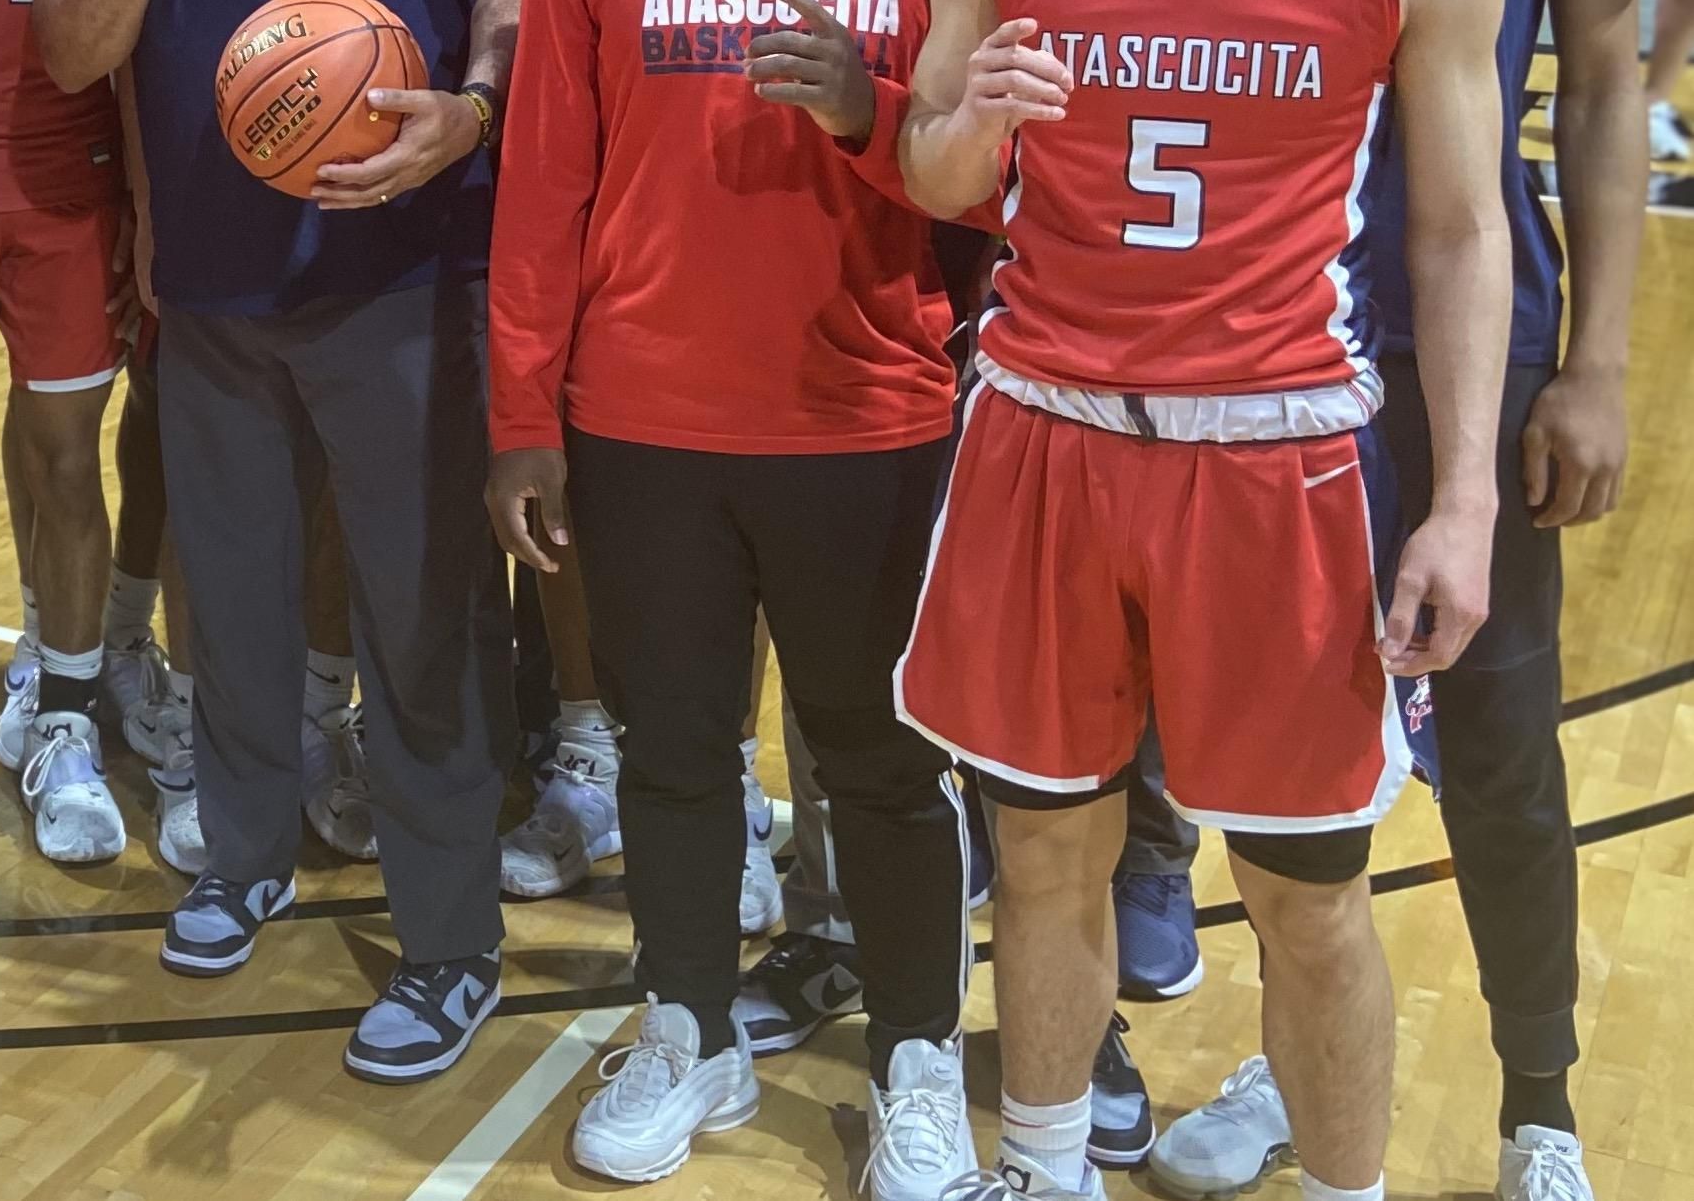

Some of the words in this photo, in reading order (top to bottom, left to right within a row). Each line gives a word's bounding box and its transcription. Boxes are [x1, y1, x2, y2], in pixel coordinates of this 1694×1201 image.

[238, 67, 318, 154] LEGACY
[269, 95, 322, 146] 1000
[1124, 118, 1207, 248] 5
